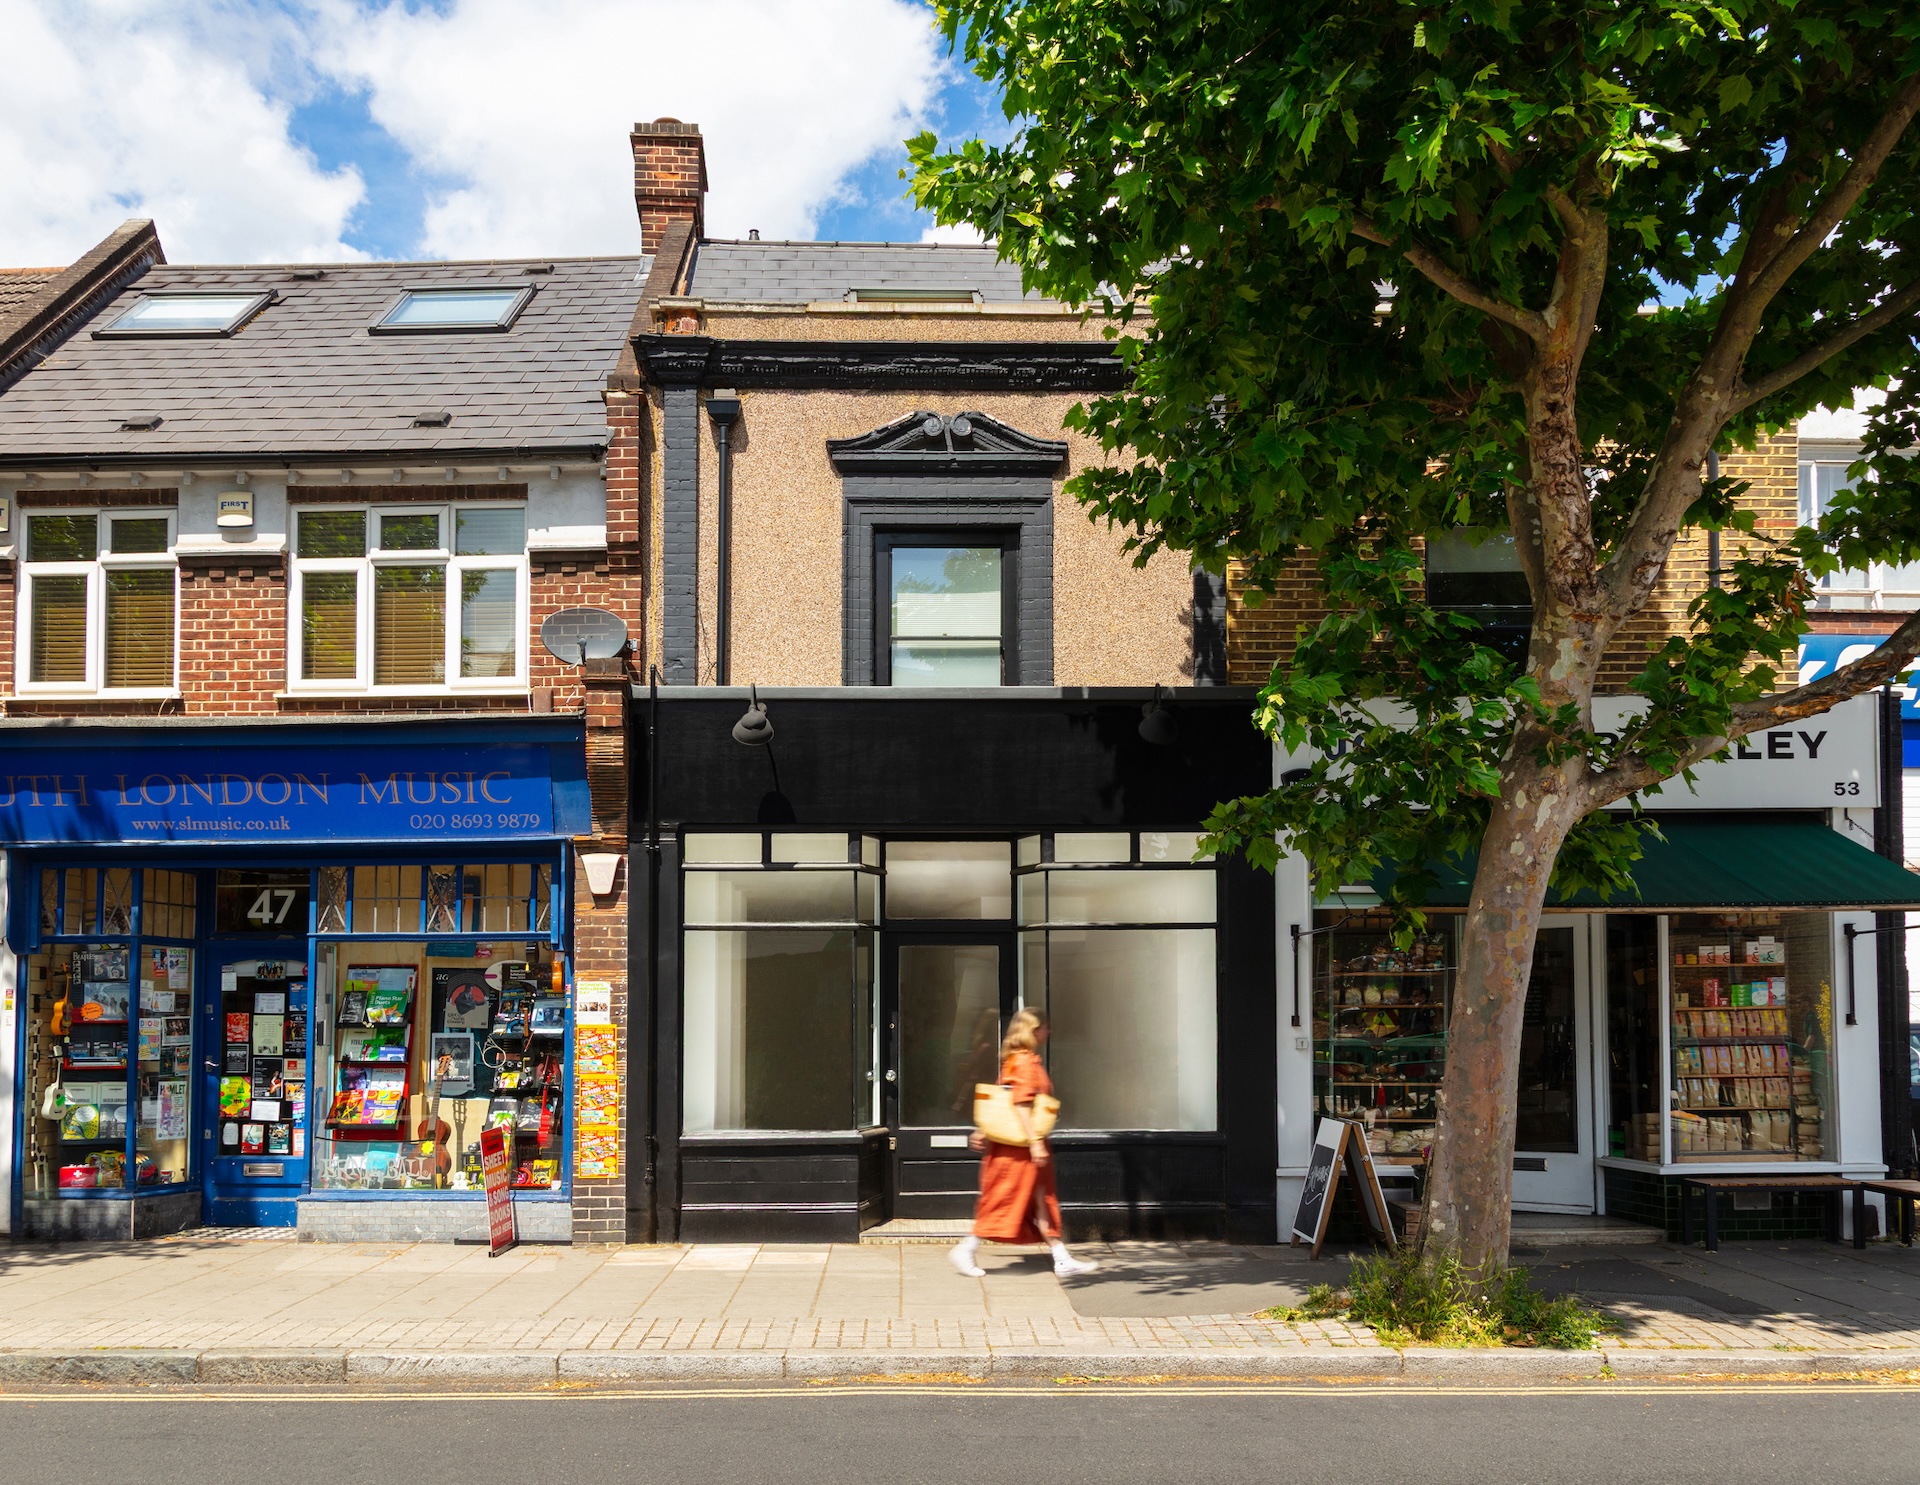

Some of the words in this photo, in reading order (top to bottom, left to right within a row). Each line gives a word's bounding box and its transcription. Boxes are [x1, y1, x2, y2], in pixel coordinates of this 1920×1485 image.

[221, 501, 249, 510] FIRST
[114, 773, 331, 806] LONDON
[356, 771, 513, 805] MUSIC
[1833, 781, 1861, 797] 53
[131, 816, 291, 832] www.slmusic.co.uk
[409, 814, 446, 830] 020
[450, 814, 494, 829] 8693
[497, 813, 541, 829] 9879
[246, 889, 296, 924] 47
[160, 1084, 186, 1095] HMLET
[484, 1150, 505, 1172] SHEET
[486, 1168, 508, 1190] MUSIC
[490, 1203, 511, 1227] BOOKS
[491, 1225, 502, 1239] SOLD
